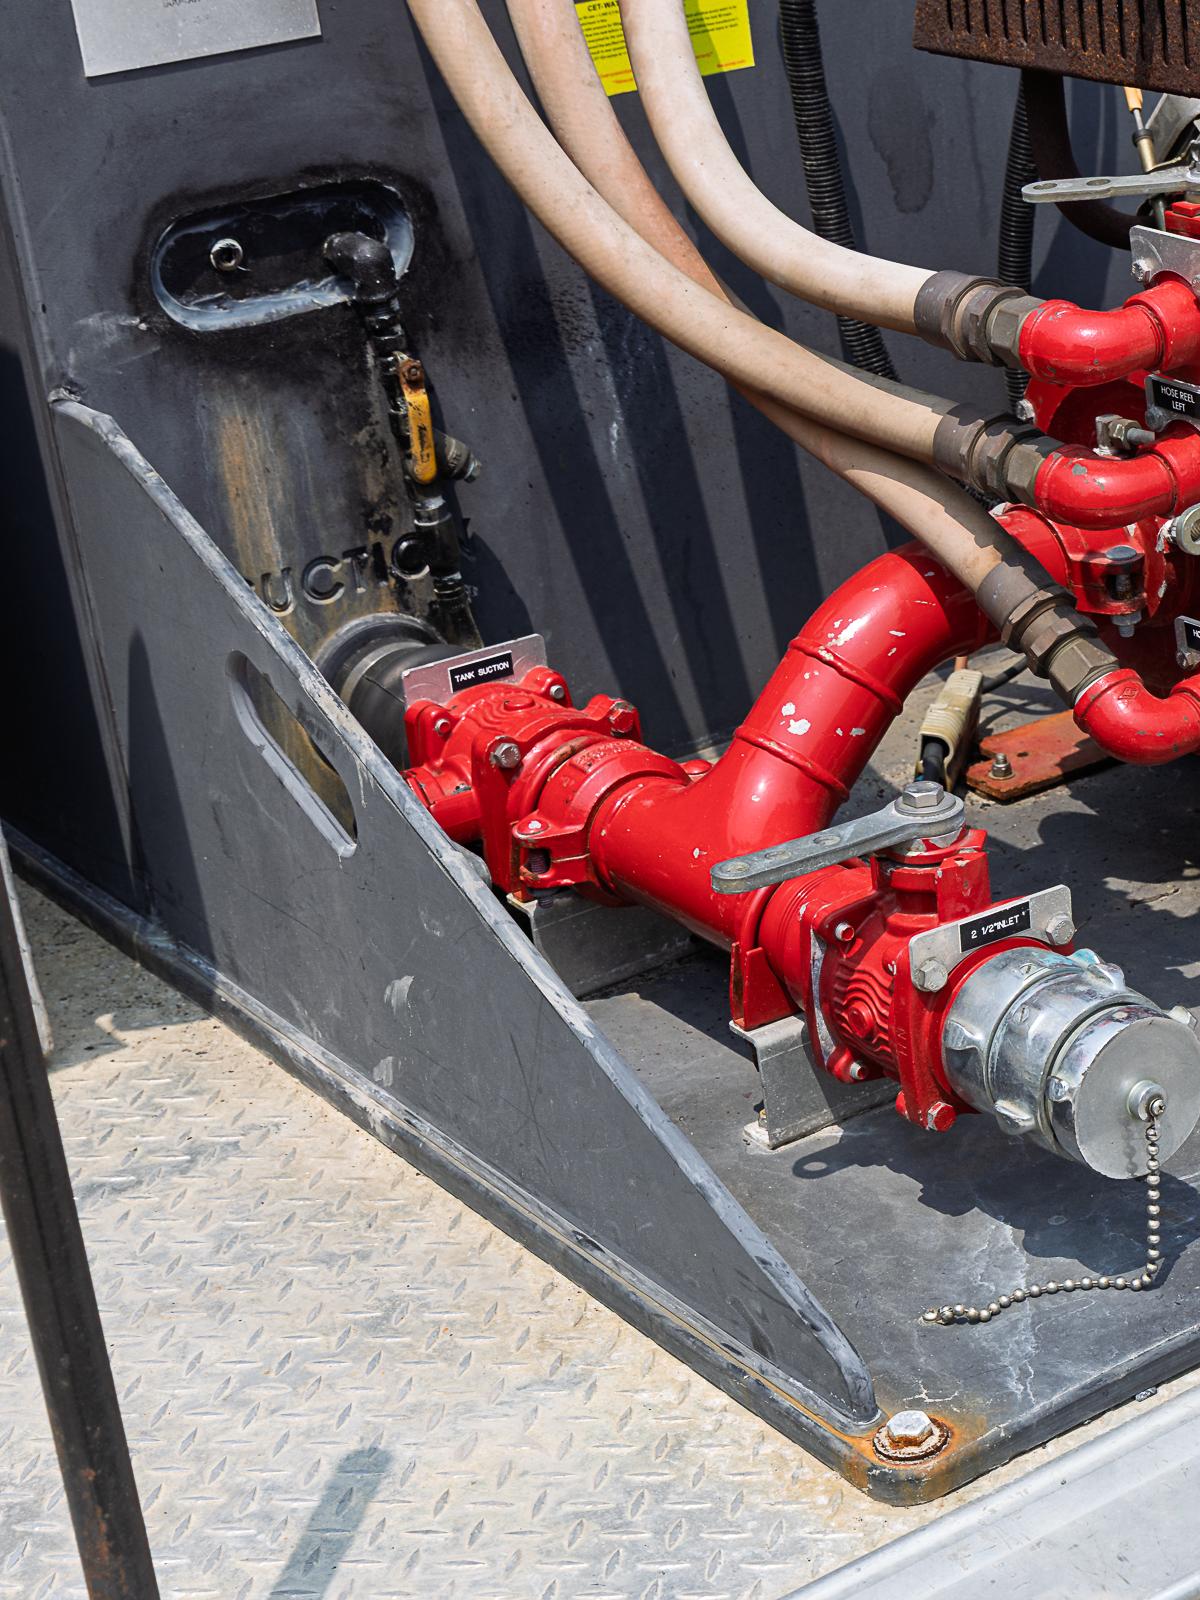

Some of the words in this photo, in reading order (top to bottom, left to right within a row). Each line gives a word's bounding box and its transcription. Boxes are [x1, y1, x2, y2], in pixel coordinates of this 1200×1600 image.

[1160, 385, 1179, 399] HOSE
[1179, 391, 1196, 404] REEL
[1171, 400, 1186, 412] LEFT
[454, 671, 475, 683] TANK
[478, 661, 510, 676] SUCTION
[970, 929, 978, 939] 2
